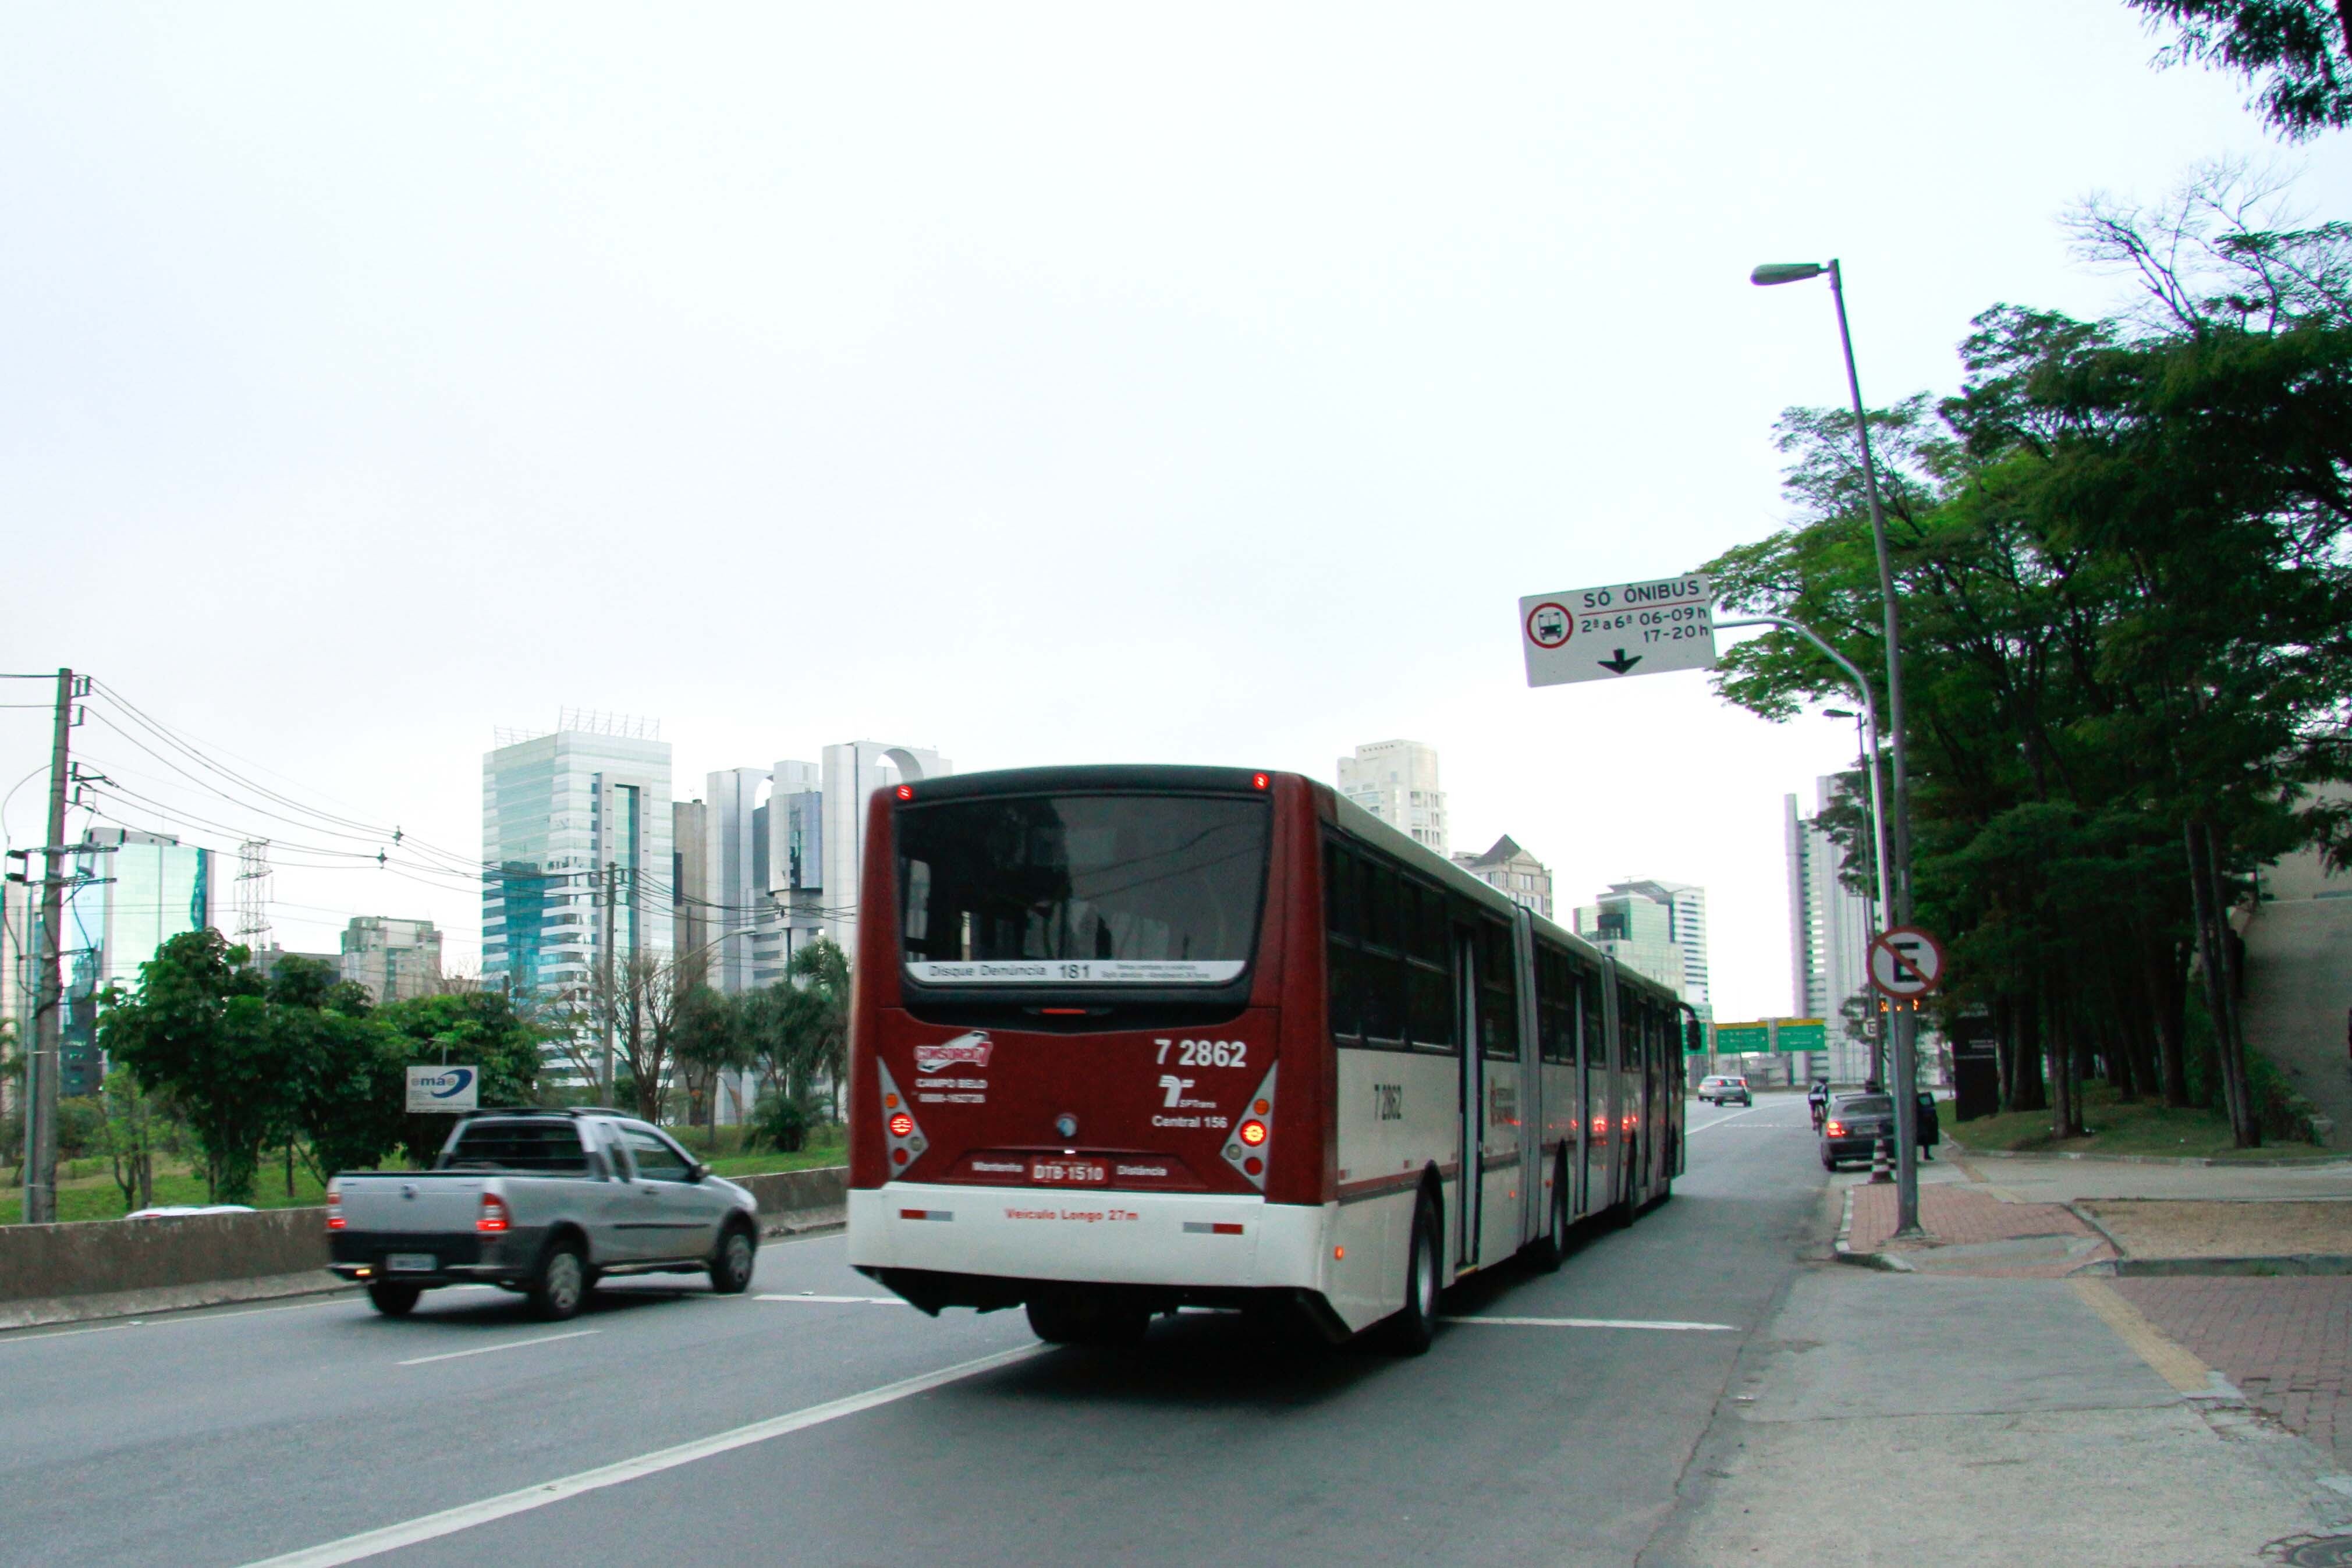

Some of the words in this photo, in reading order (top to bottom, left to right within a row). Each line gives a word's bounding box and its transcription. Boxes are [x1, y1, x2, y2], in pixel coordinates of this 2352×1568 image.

[1583, 587, 1611, 608] SÓ
[1624, 580, 1700, 604] ÔNIBUS
[930, 964, 974, 978] Disque
[980, 964, 1047, 977] Denúncia
[1059, 964, 1090, 978] 181
[1154, 1038, 1172, 1065] 7
[1178, 1039, 1247, 1067] 2862
[410, 1077, 455, 1086] emae
[1151, 1115, 1201, 1127] Central
[1204, 1116, 1228, 1129] 156
[1061, 1209, 1104, 1223] Longo
[1108, 1209, 1139, 1221] 27m
